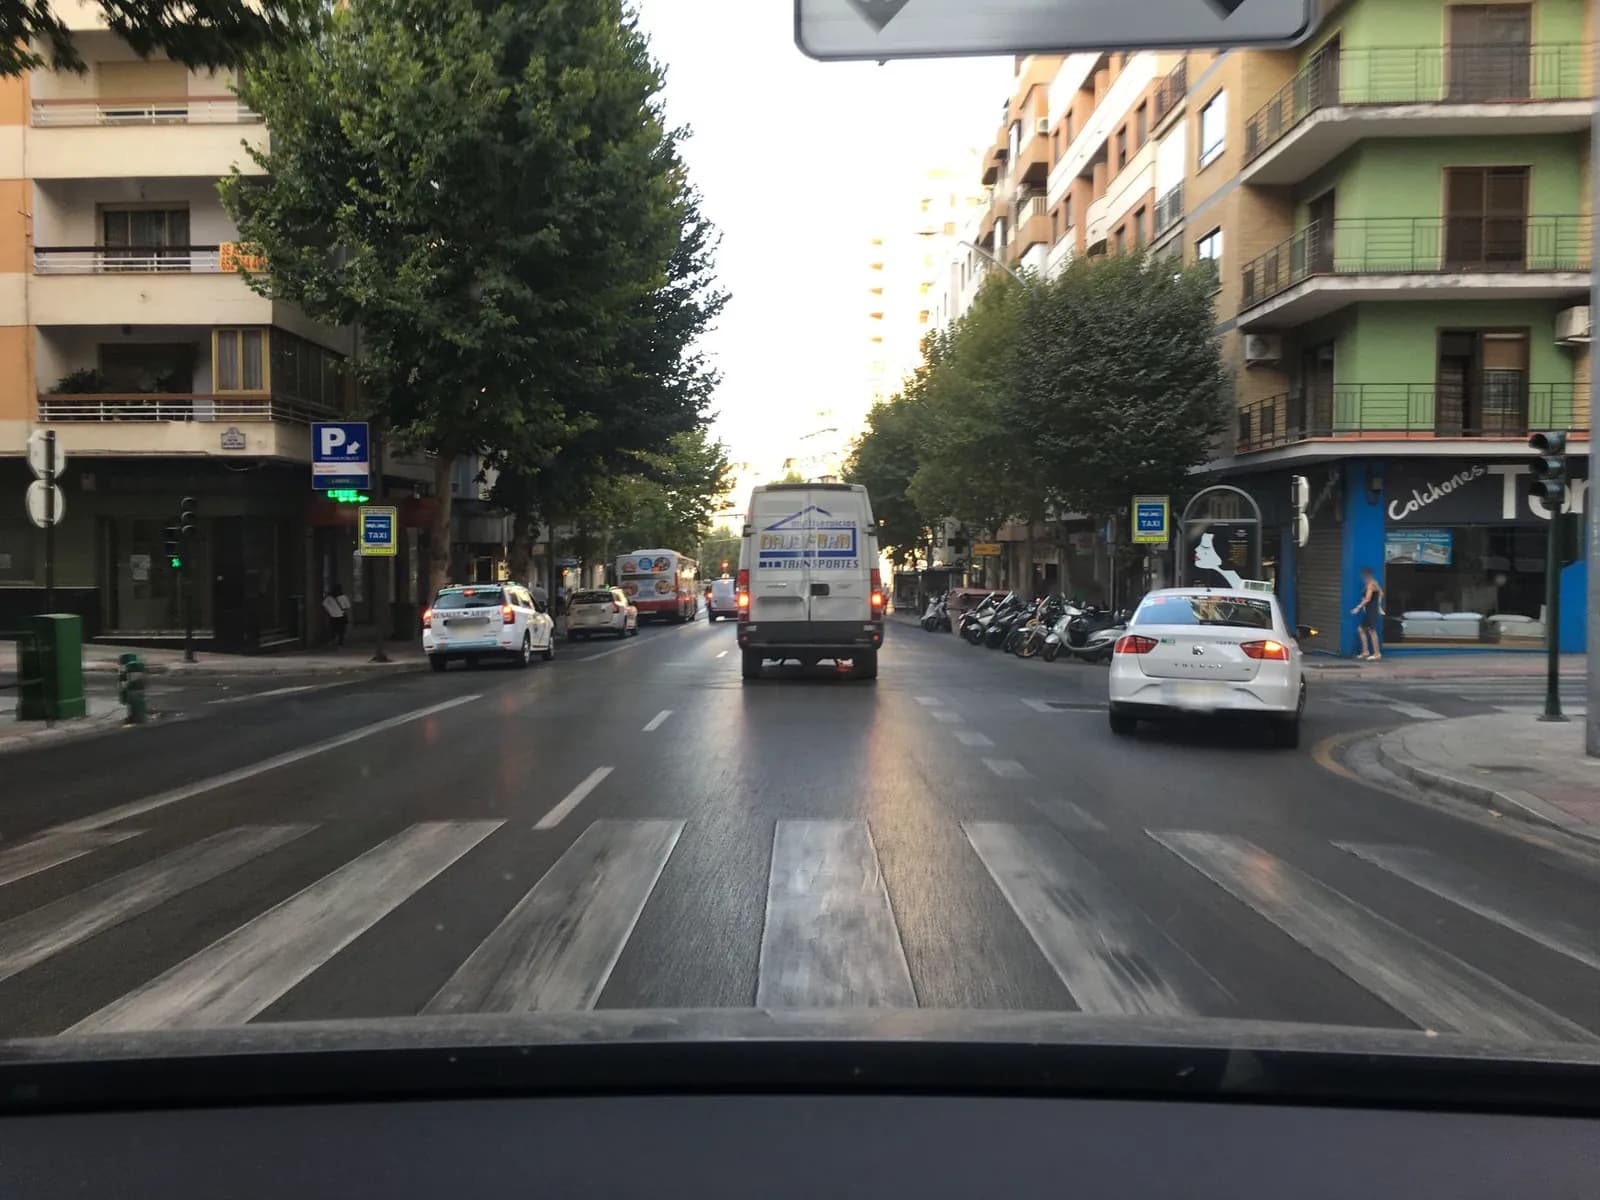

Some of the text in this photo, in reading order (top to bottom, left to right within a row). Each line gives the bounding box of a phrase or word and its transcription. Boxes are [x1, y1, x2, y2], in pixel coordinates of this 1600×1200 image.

[321, 428, 346, 455] P
[1388, 464, 1485, 520] Colchones
[782, 559, 859, 568] TRANSPORTES
